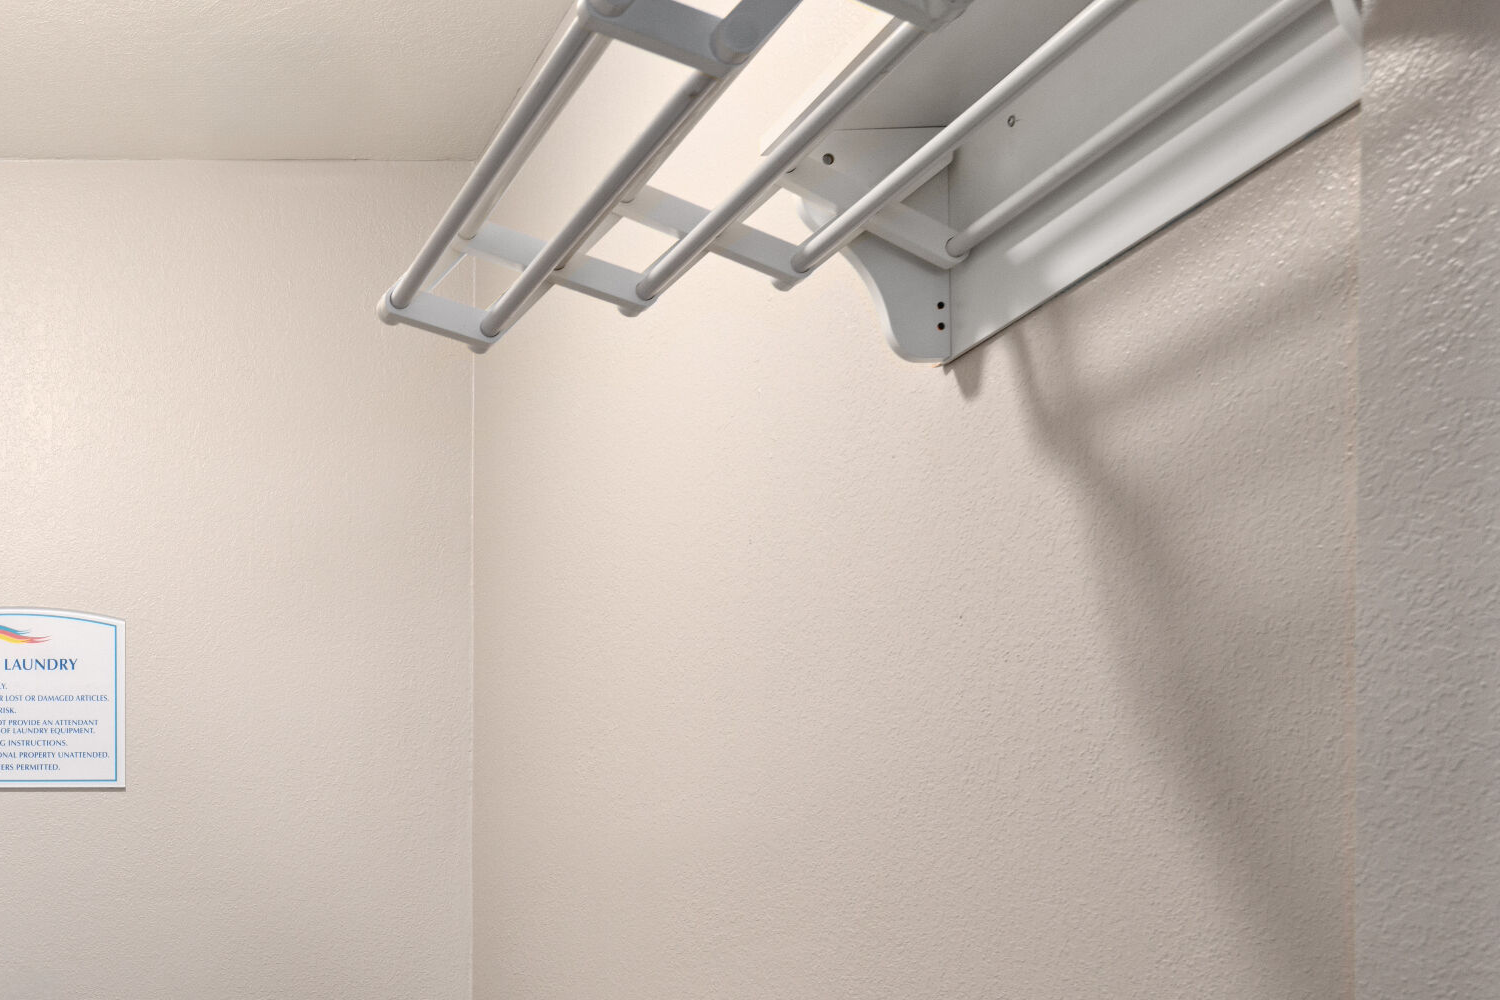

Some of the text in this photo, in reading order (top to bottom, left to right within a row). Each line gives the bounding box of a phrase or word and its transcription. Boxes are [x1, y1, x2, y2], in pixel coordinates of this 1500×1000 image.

[4, 658, 78, 671] LAUNDRY
[5, 694, 23, 702] LOST
[24, 694, 36, 702] OR
[37, 694, 74, 702] DAMAGED
[75, 694, 110, 702] ARTICLES.
[50, 727, 96, 735] EQUIPMENT.
[8, 739, 68, 747] INSTRUCTIONS.
[18, 751, 56, 759] PROPERTY
[57, 751, 110, 759] UNATTENDED.
[16, 763, 60, 771] PERMITTED.
